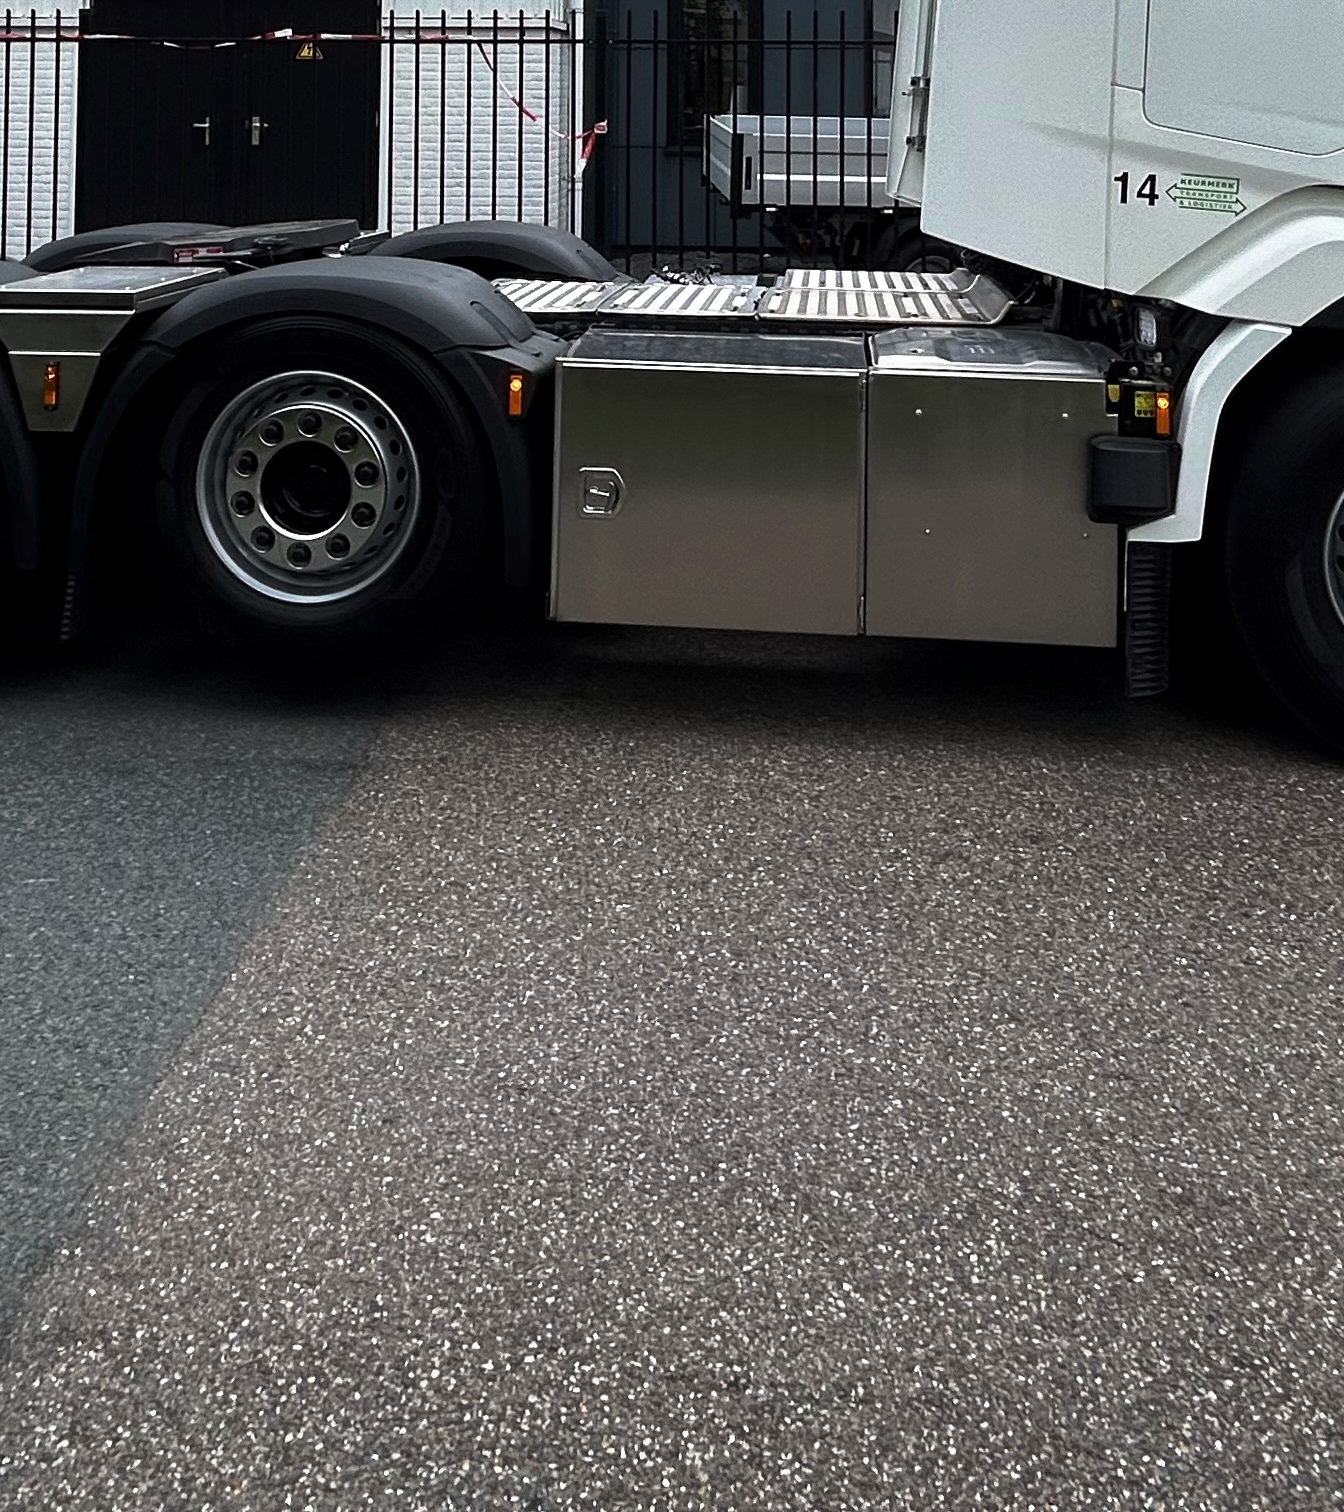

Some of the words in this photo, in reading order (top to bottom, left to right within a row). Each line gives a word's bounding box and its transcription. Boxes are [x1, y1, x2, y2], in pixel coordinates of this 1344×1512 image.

[1113, 171, 1160, 206] 14
[1180, 178, 1236, 189] KEURMERK
[1180, 190, 1233, 200] TRANSPORT
